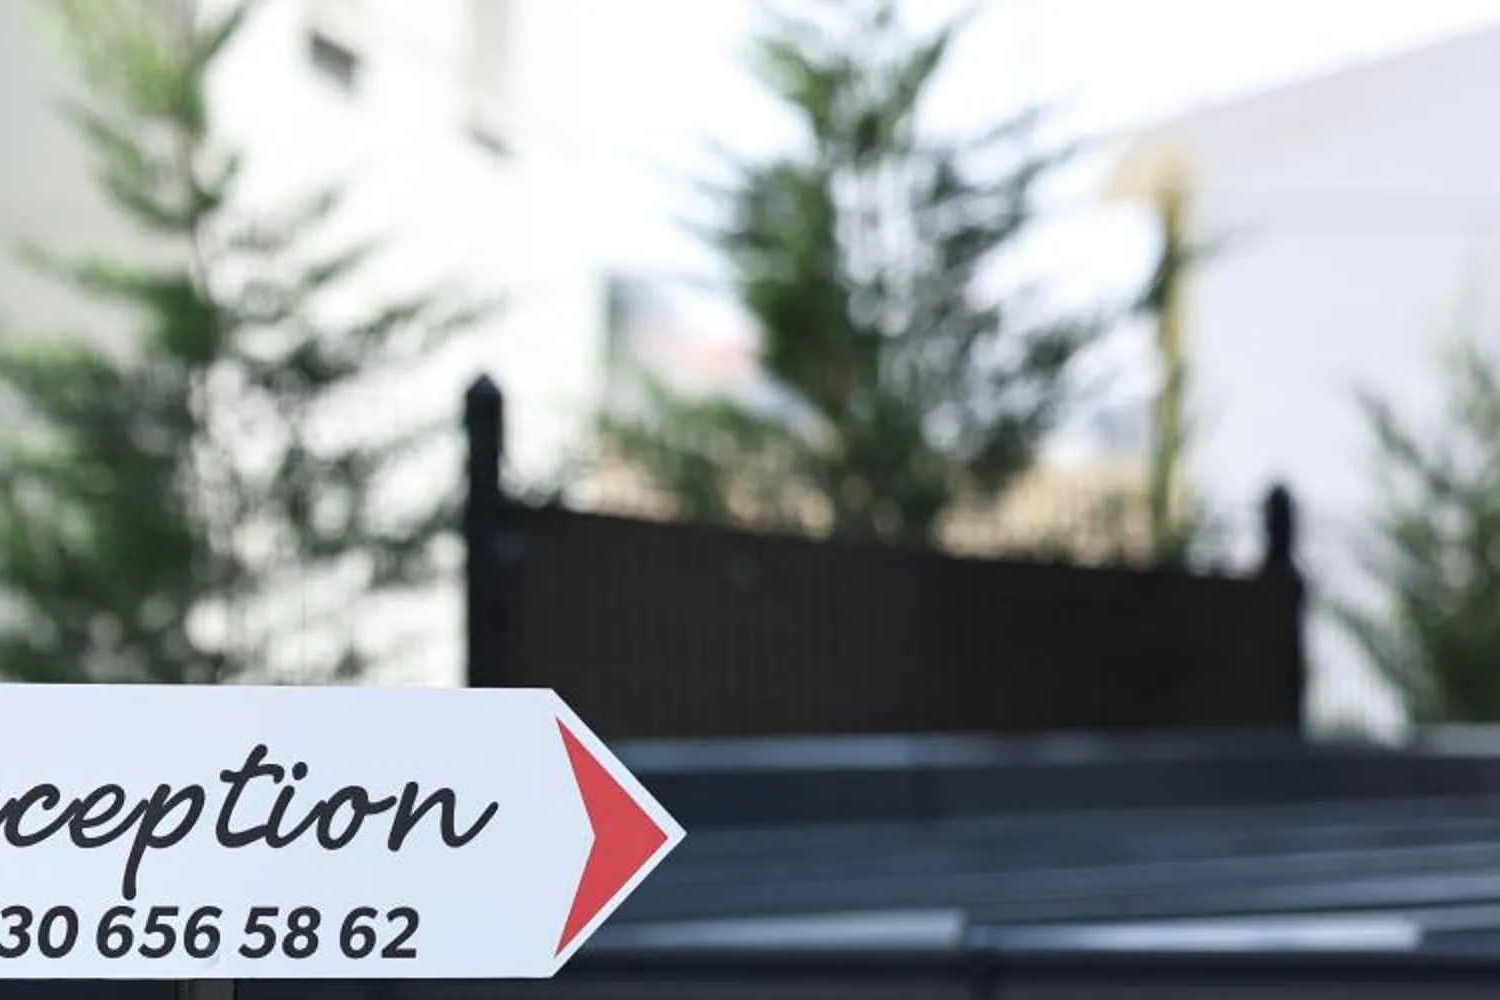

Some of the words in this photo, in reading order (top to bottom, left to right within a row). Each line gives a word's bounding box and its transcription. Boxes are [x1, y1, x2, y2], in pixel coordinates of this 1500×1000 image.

[96, 905, 223, 959] 656
[238, 905, 321, 959] 58
[339, 905, 420, 959] 62
